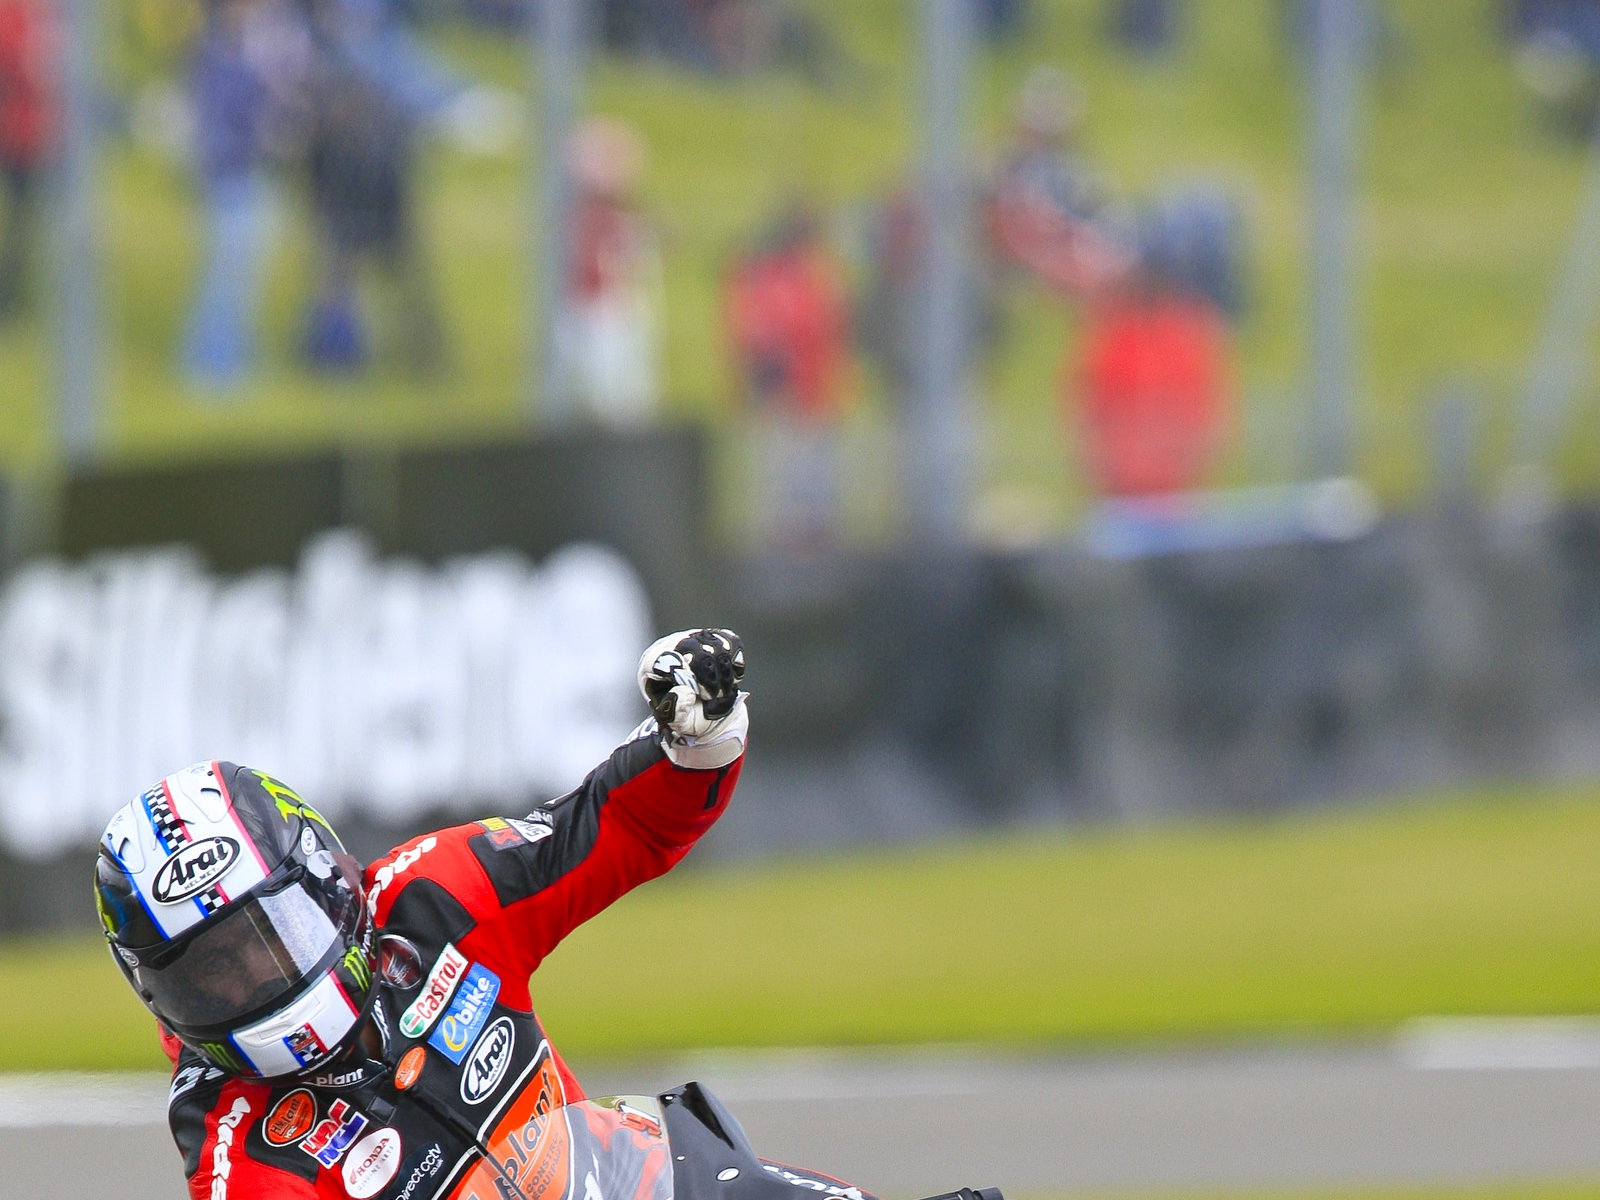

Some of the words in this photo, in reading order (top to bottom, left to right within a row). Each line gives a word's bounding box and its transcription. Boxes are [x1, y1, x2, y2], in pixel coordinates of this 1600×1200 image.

[161, 837, 229, 900] Arai
[416, 953, 462, 1019] Castrol
[316, 1068, 364, 1086] plant
[470, 1019, 507, 1100] Arai
[356, 1137, 391, 1177] HONDA
